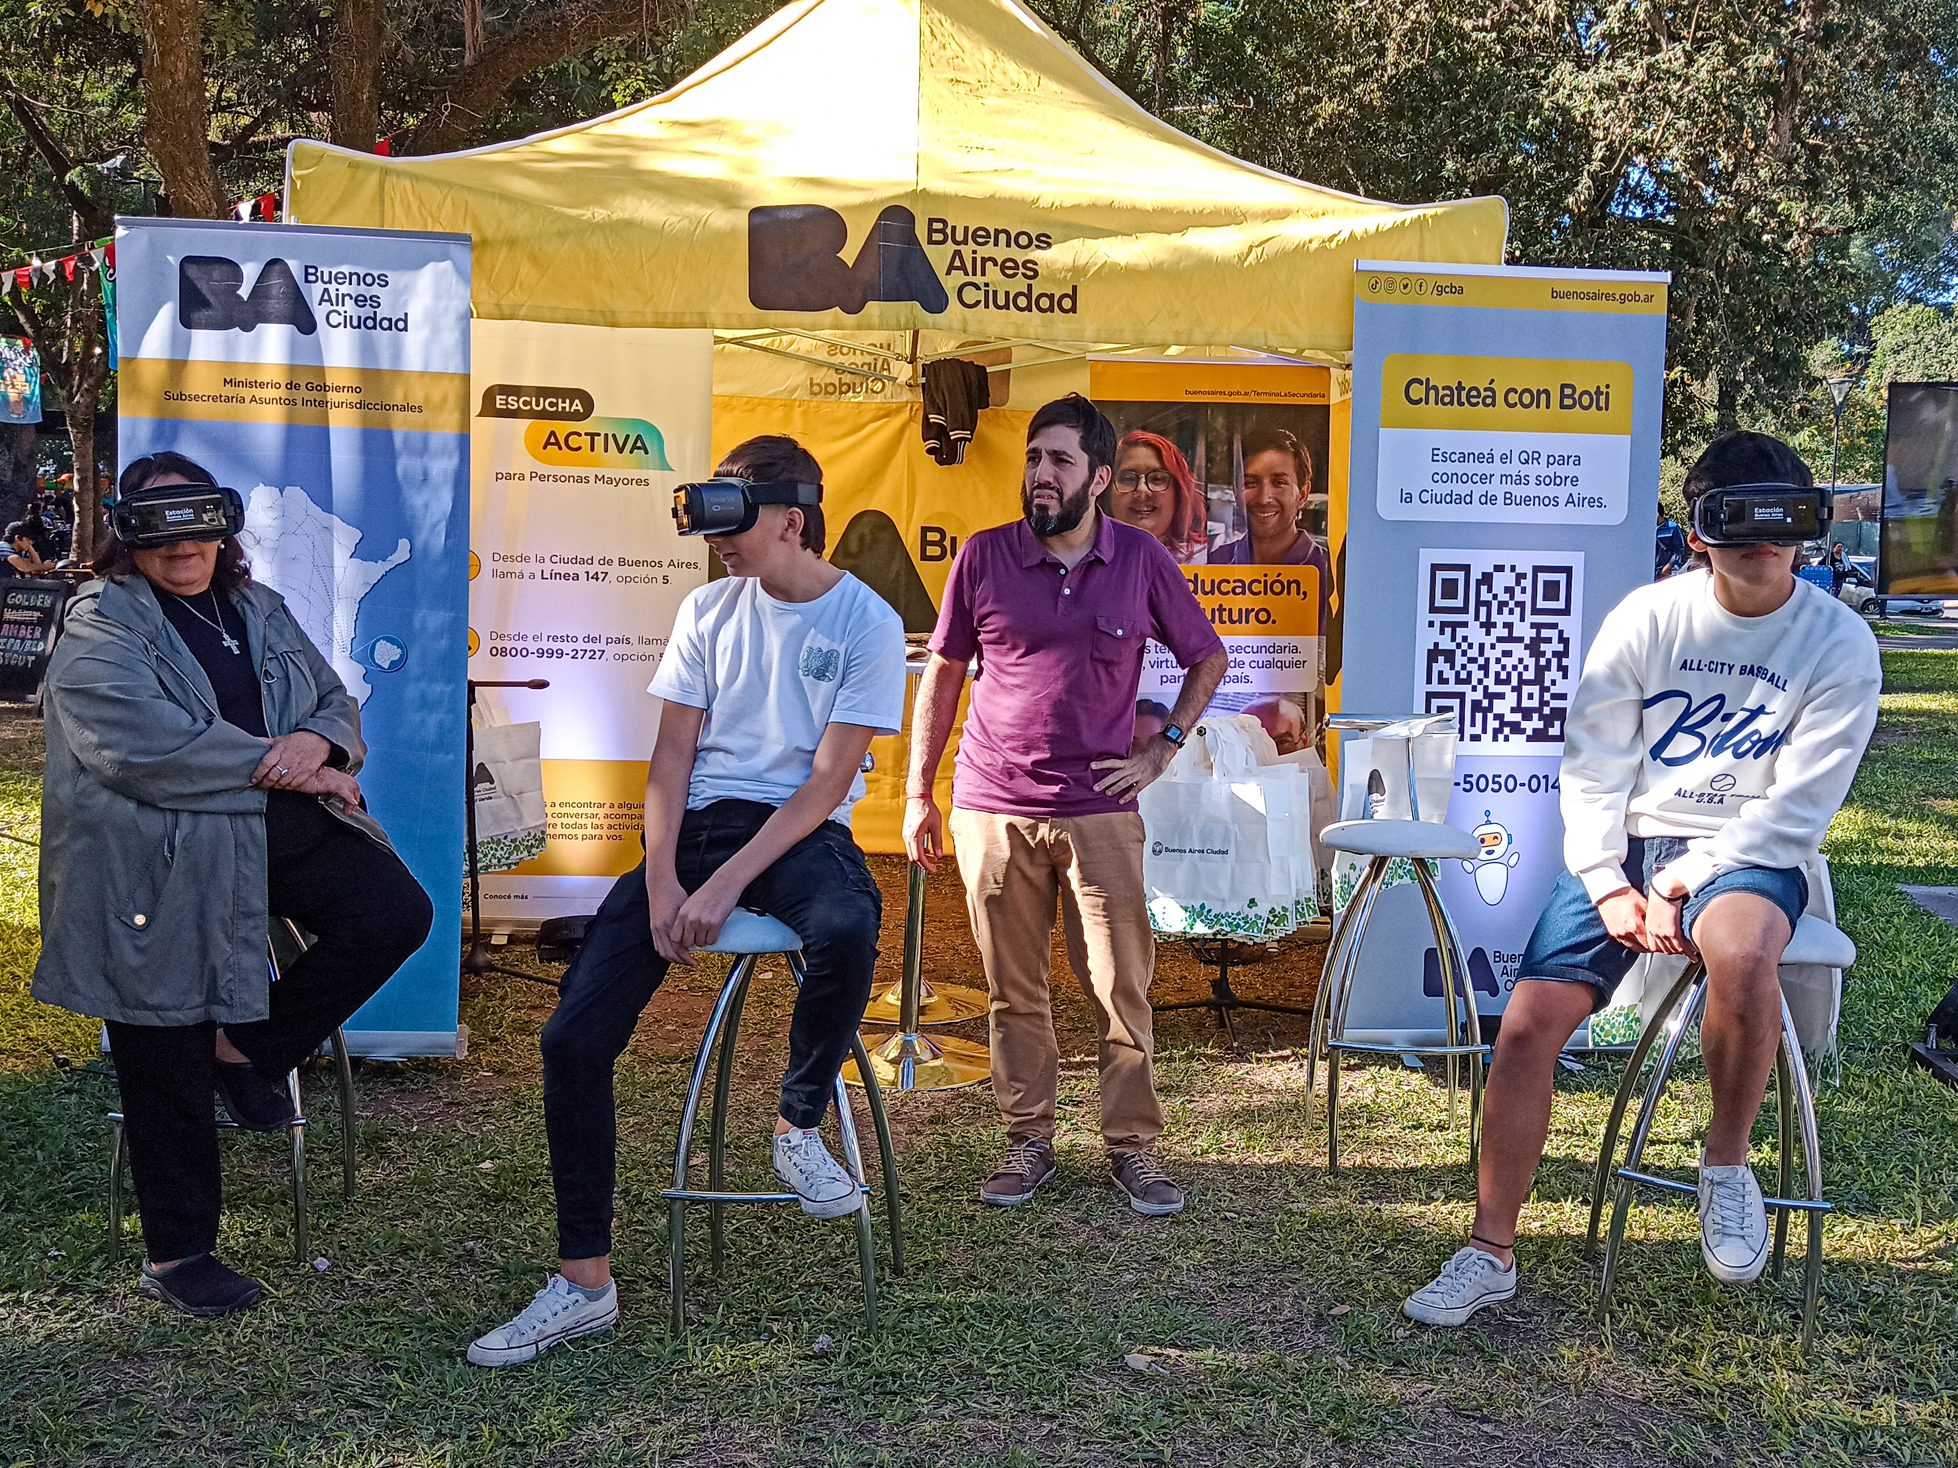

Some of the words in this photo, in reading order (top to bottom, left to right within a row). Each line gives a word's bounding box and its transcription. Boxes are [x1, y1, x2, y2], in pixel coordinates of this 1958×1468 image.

[926, 217, 1053, 251] Buenos
[748, 204, 949, 315] BA
[945, 249, 1040, 281] Aires
[303, 264, 390, 288] Buenos
[179, 255, 318, 336] BA
[1430, 281, 1464, 297] /gcba
[1550, 286, 1655, 304] buenosaires.gob.ar
[317, 287, 382, 309] Aires
[956, 281, 1078, 315] Ciudad
[325, 309, 409, 333] Ciudad
[223, 377, 282, 391] Ministerio
[285, 380, 302, 391] de
[305, 381, 362, 394] Gobierno
[1184, 388, 1326, 399] buenosaires.gob.ar/TerminaLaSecundaria
[1403, 376, 1497, 409] Chateá
[1503, 385, 1551, 410] con
[1558, 382, 1611, 412] Boti
[163, 390, 246, 404] Subsecretaría
[249, 394, 298, 407] Asuntos
[301, 397, 424, 414] Interjurisdiccionales
[495, 395, 584, 413] ESCUCHA
[541, 429, 650, 455] ACTIVA
[1430, 447, 1495, 464] Escaneá
[1499, 449, 1513, 465] el
[1518, 450, 1542, 466] QR
[1546, 453, 1581, 469] para
[495, 470, 525, 483] para
[529, 471, 590, 484] Personas
[594, 474, 650, 488] Mayores
[1431, 471, 1495, 485] conocer
[1499, 470, 1530, 486] más
[1534, 471, 1579, 487] sobre
[1400, 488, 1413, 504] la
[1418, 489, 1474, 506] Ciudad
[1478, 490, 1498, 506] de
[1503, 491, 1560, 508] Buenos
[1564, 493, 1607, 509] Aires.
[492, 552, 531, 564] Desde
[535, 553, 545, 564] la
[549, 554, 594, 566] Ciudad
[598, 556, 614, 567] de
[617, 556, 664, 568] Buenos
[667, 558, 701, 571] Aires,
[491, 568, 525, 580] llamá
[528, 571, 536, 580] a
[540, 569, 580, 582] Línea
[584, 571, 612, 584] 147,
[616, 573, 658, 585] opción
[661, 574, 673, 585] 5.
[1187, 572, 1308, 601] ducación,
[7, 592, 53, 608] GOLDEN
[1200, 602, 1277, 625] turo.
[0, 623, 42, 639] AMBER
[489, 630, 529, 642] Desde
[532, 631, 543, 643] el
[546, 633, 578, 644] resto
[582, 633, 602, 645] del
[605, 633, 634, 646] país,
[638, 635, 670, 647] llamá
[489, 646, 609, 662] 0800-999-2727,
[613, 650, 655, 663] opción
[1228, 643, 1302, 655] secundaria.
[1149, 657, 1179, 669] virtu
[1228, 657, 1246, 669] de
[1248, 657, 1308, 671] cualquier
[1223, 671, 1253, 686] país.
[1453, 773, 1560, 794] -5050-014
[558, 801, 607, 809] encontrar
[617, 801, 645, 811] alguie
[551, 812, 601, 821] conversar,
[603, 812, 645, 821] acompa
[560, 821, 588, 830] todas
[590, 821, 605, 830] las
[607, 822, 645, 831] activida
[545, 832, 579, 841] nemos
[581, 833, 603, 842] para
[605, 833, 626, 841] vos.
[1164, 846, 1187, 854] Buenos
[1188, 847, 1205, 855] Aires
[1206, 848, 1229, 856] Ciudad
[483, 892, 512, 900] Conocé
[1493, 950, 1524, 964] Buen
[1500, 964, 1519, 978] Air
